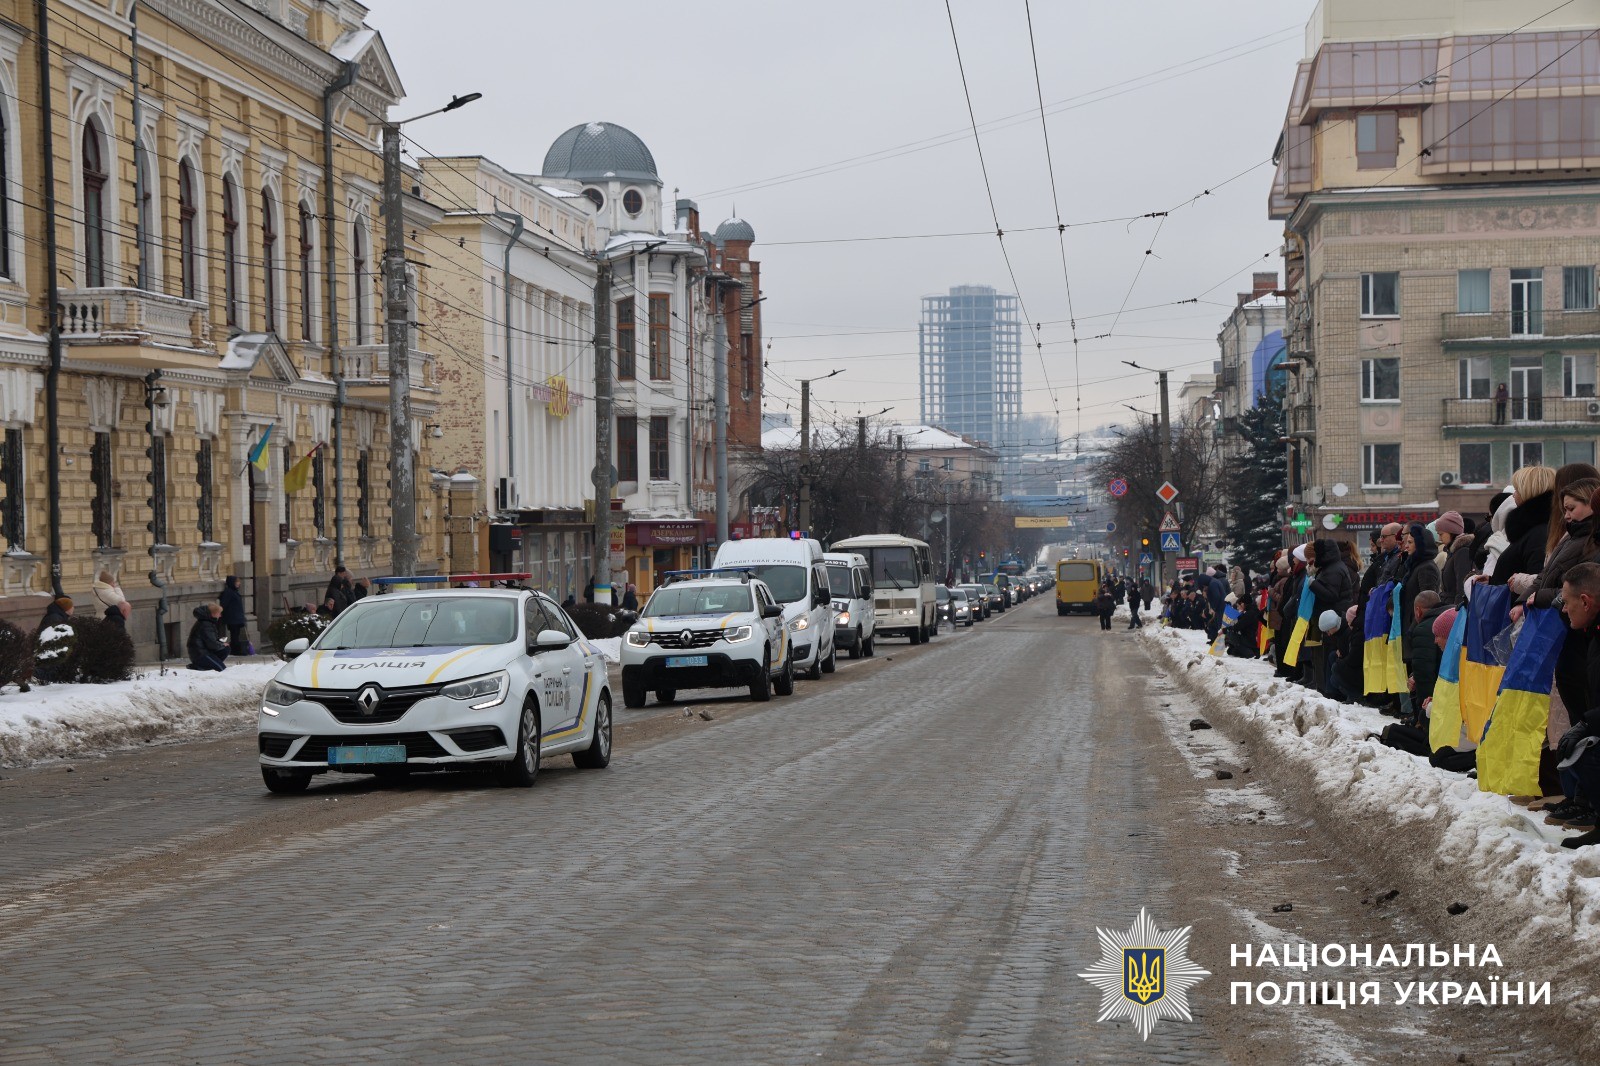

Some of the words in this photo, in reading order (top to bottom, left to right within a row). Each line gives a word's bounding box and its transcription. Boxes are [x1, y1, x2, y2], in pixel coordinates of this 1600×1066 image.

[1346, 512, 1405, 523] АПТЕКА
[686, 656, 703, 664] 1033
[331, 661, 426, 670] ПОЛІЦІЯ
[545, 691, 564, 707] ПОЛІЦІЯ
